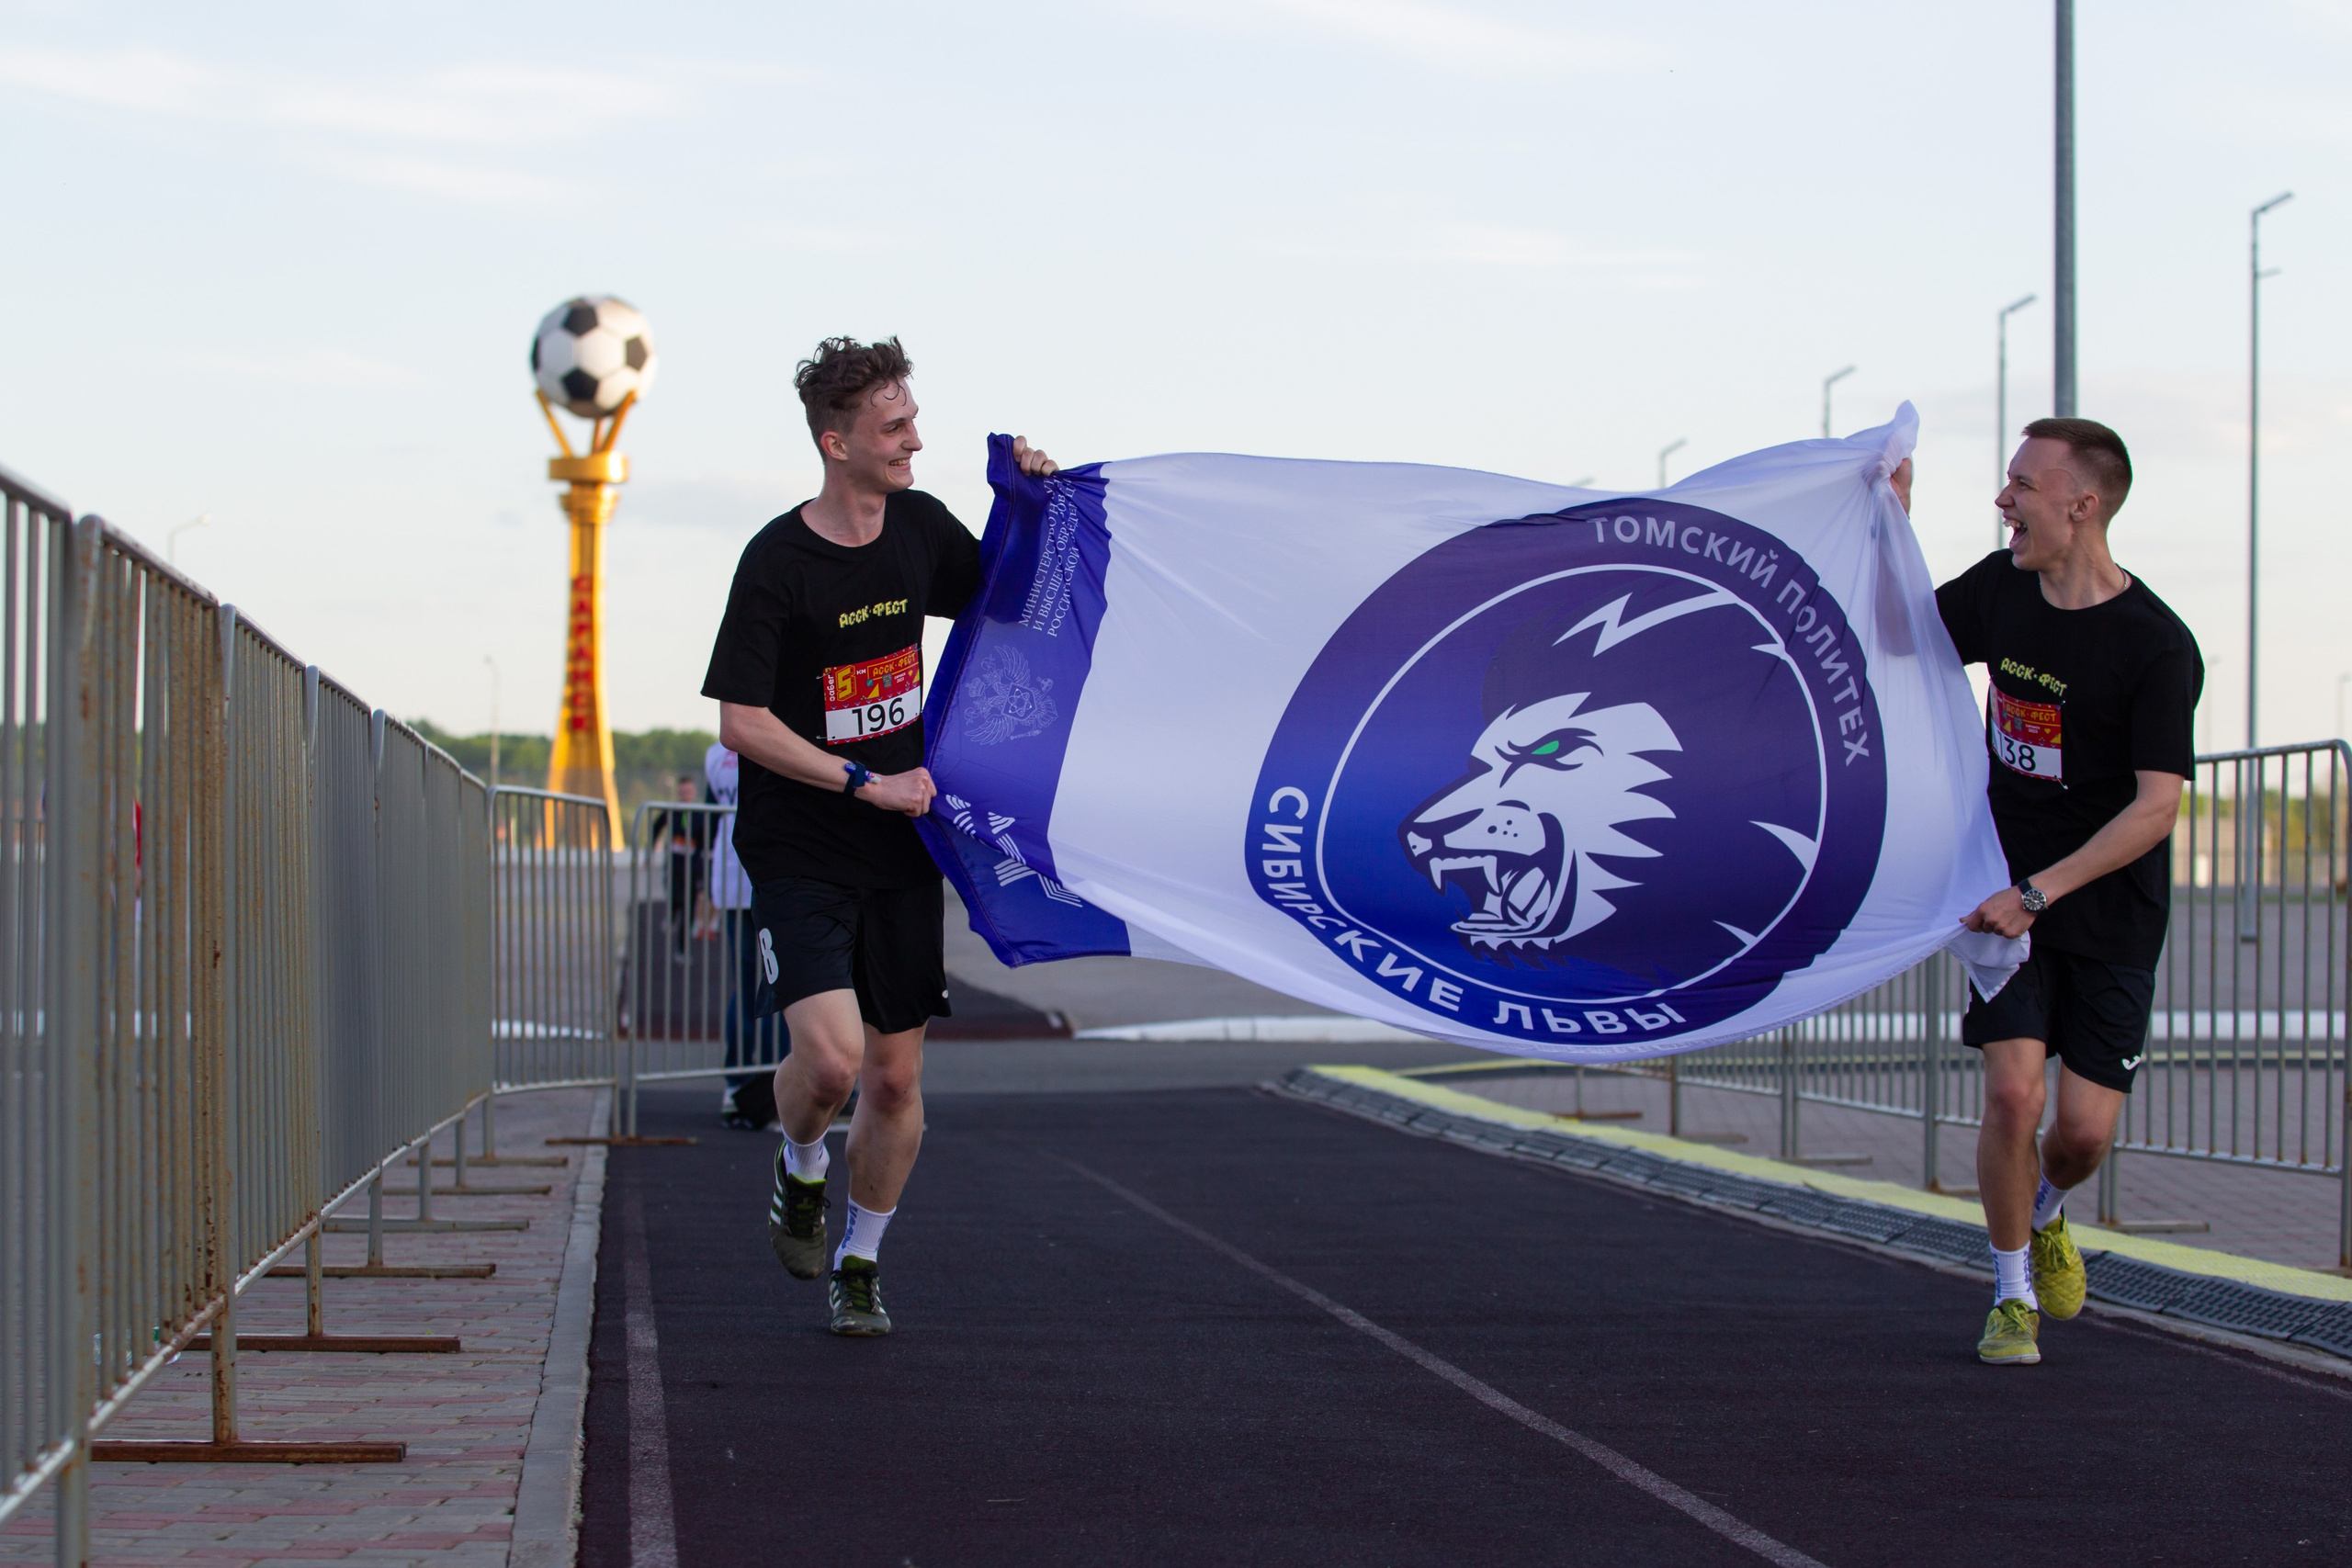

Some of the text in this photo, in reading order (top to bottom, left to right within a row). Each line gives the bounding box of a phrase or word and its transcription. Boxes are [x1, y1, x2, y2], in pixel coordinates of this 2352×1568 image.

[1033, 621, 1043, 632] И
[1587, 515, 1870, 767] ТОМСКИЙ ПОЛИТЕХ
[835, 665, 856, 702] 5
[852, 697, 904, 735] 196
[1261, 786, 1687, 1034] СИБИРСКИЕ ЛЬВЫ
